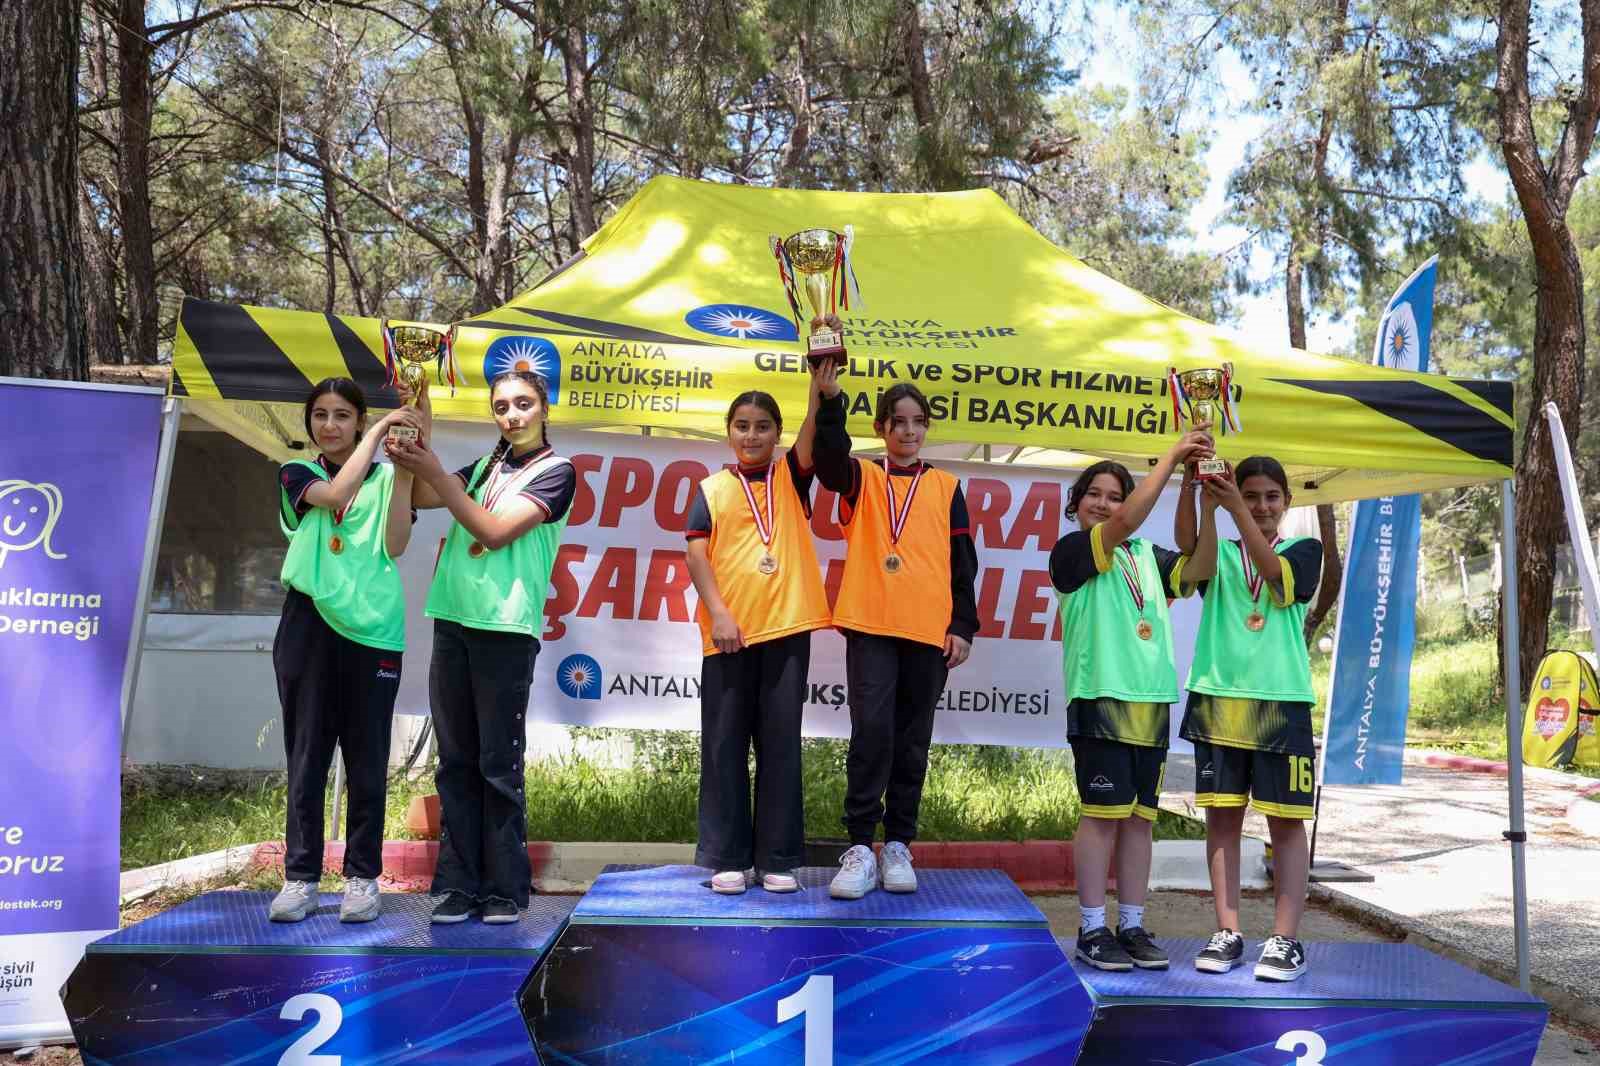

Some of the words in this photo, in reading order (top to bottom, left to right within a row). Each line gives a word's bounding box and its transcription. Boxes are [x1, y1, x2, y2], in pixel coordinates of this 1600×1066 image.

[571, 341, 667, 361] ANTALYA
[570, 360, 713, 390] BÜYÜKŞEHİR
[907, 363, 943, 381] ve
[951, 363, 1042, 387] SPOR
[568, 389, 681, 413] BELEDİYESİ
[967, 397, 1167, 434] BAŞKANLIĞI
[1354, 675, 1377, 771] ANTALYA
[1369, 523, 1394, 668] BÜYÜKŞEHİR
[1288, 755, 1312, 792] 16
[277, 992, 343, 1066] 2
[777, 974, 834, 1066] 1
